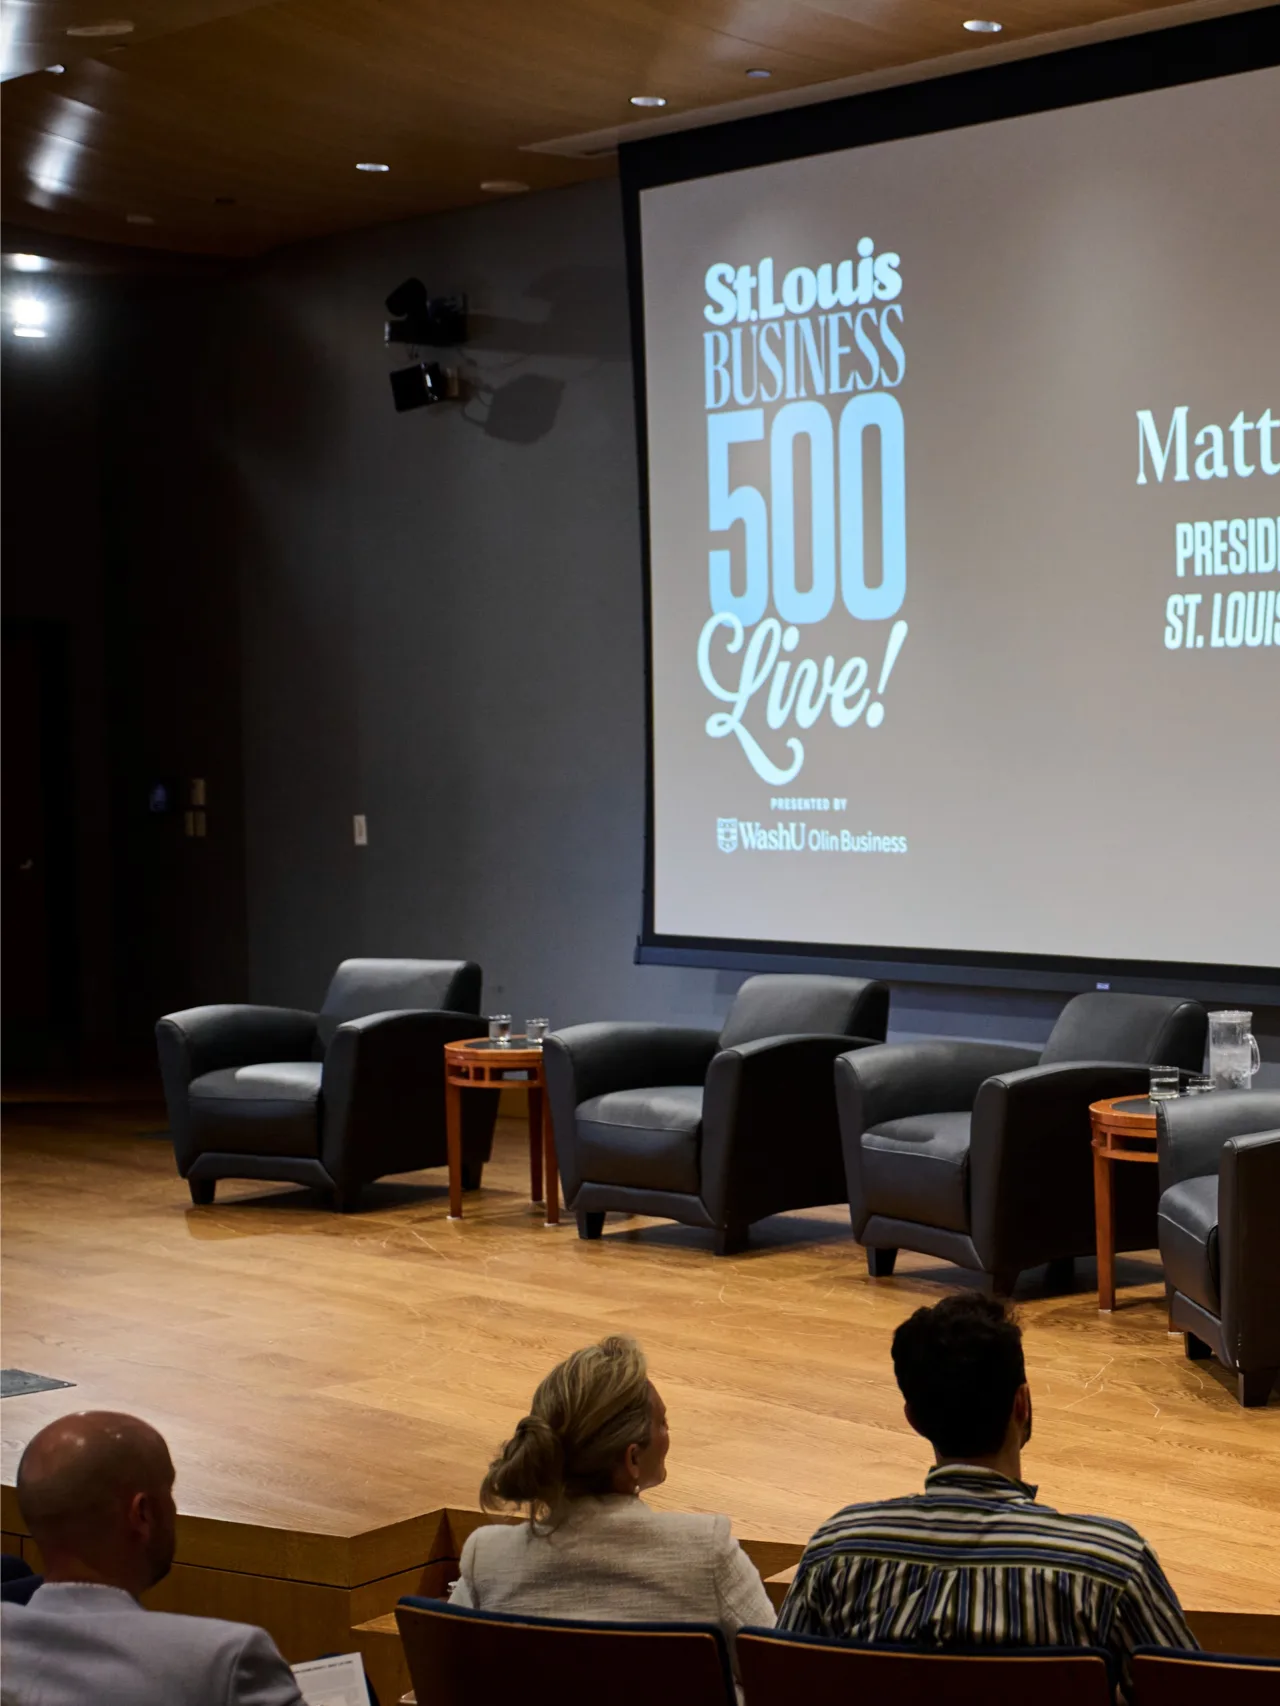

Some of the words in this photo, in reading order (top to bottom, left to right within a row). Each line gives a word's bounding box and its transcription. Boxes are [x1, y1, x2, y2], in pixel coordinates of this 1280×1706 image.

[703, 304, 906, 409] BUSINESS
[707, 391, 908, 628] 500
[1164, 593, 1204, 650] ST.
[697, 611, 908, 786] Live!
[738, 821, 806, 851] WashU
[808, 828, 839, 852] Olin
[841, 829, 908, 854] Business
[770, 797, 830, 811] PRESENTED
[833, 798, 847, 811] BY
